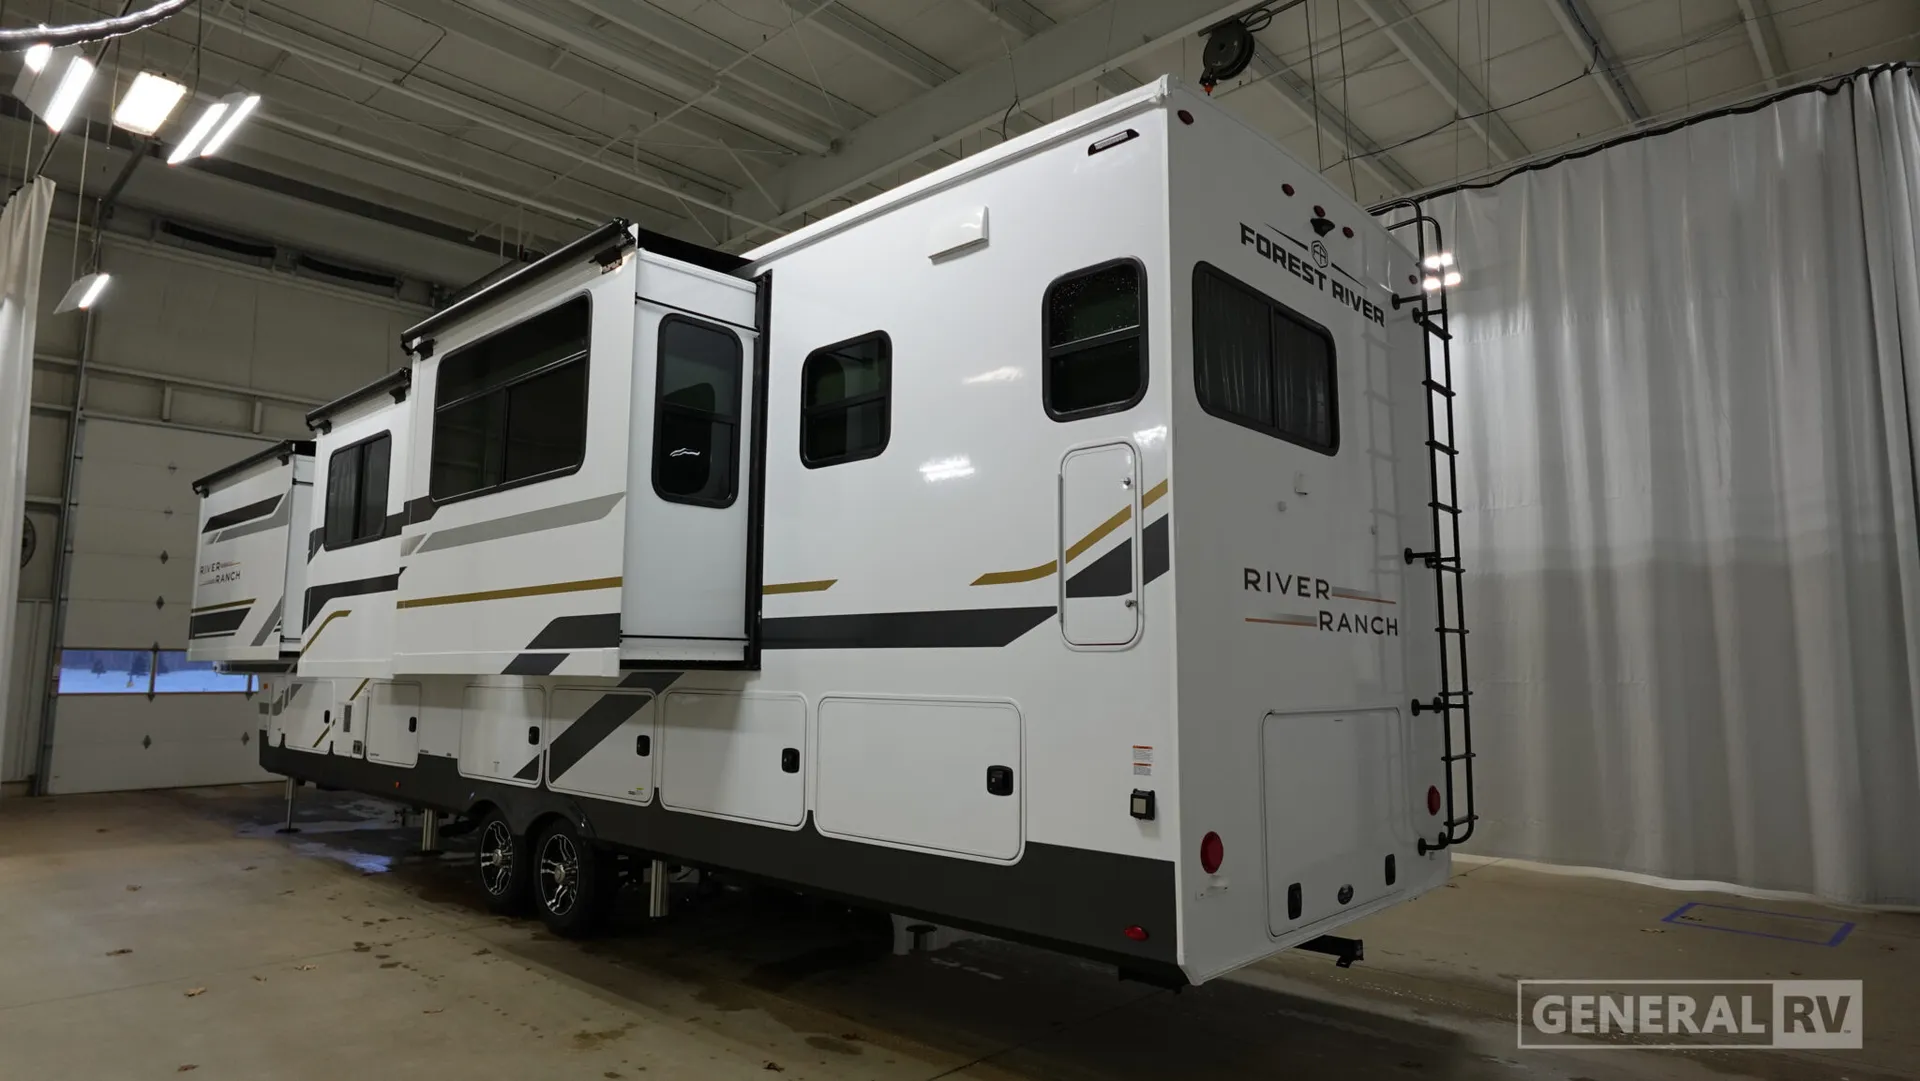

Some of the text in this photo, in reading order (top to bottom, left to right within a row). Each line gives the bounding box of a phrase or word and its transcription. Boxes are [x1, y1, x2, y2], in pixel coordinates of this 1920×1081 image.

[1239, 222, 1385, 328] FOREST RIVER
[200, 561, 220, 574] RIVER
[216, 571, 241, 583] RANCH
[1244, 568, 1330, 600] RIVER
[1319, 610, 1398, 636] RANCH
